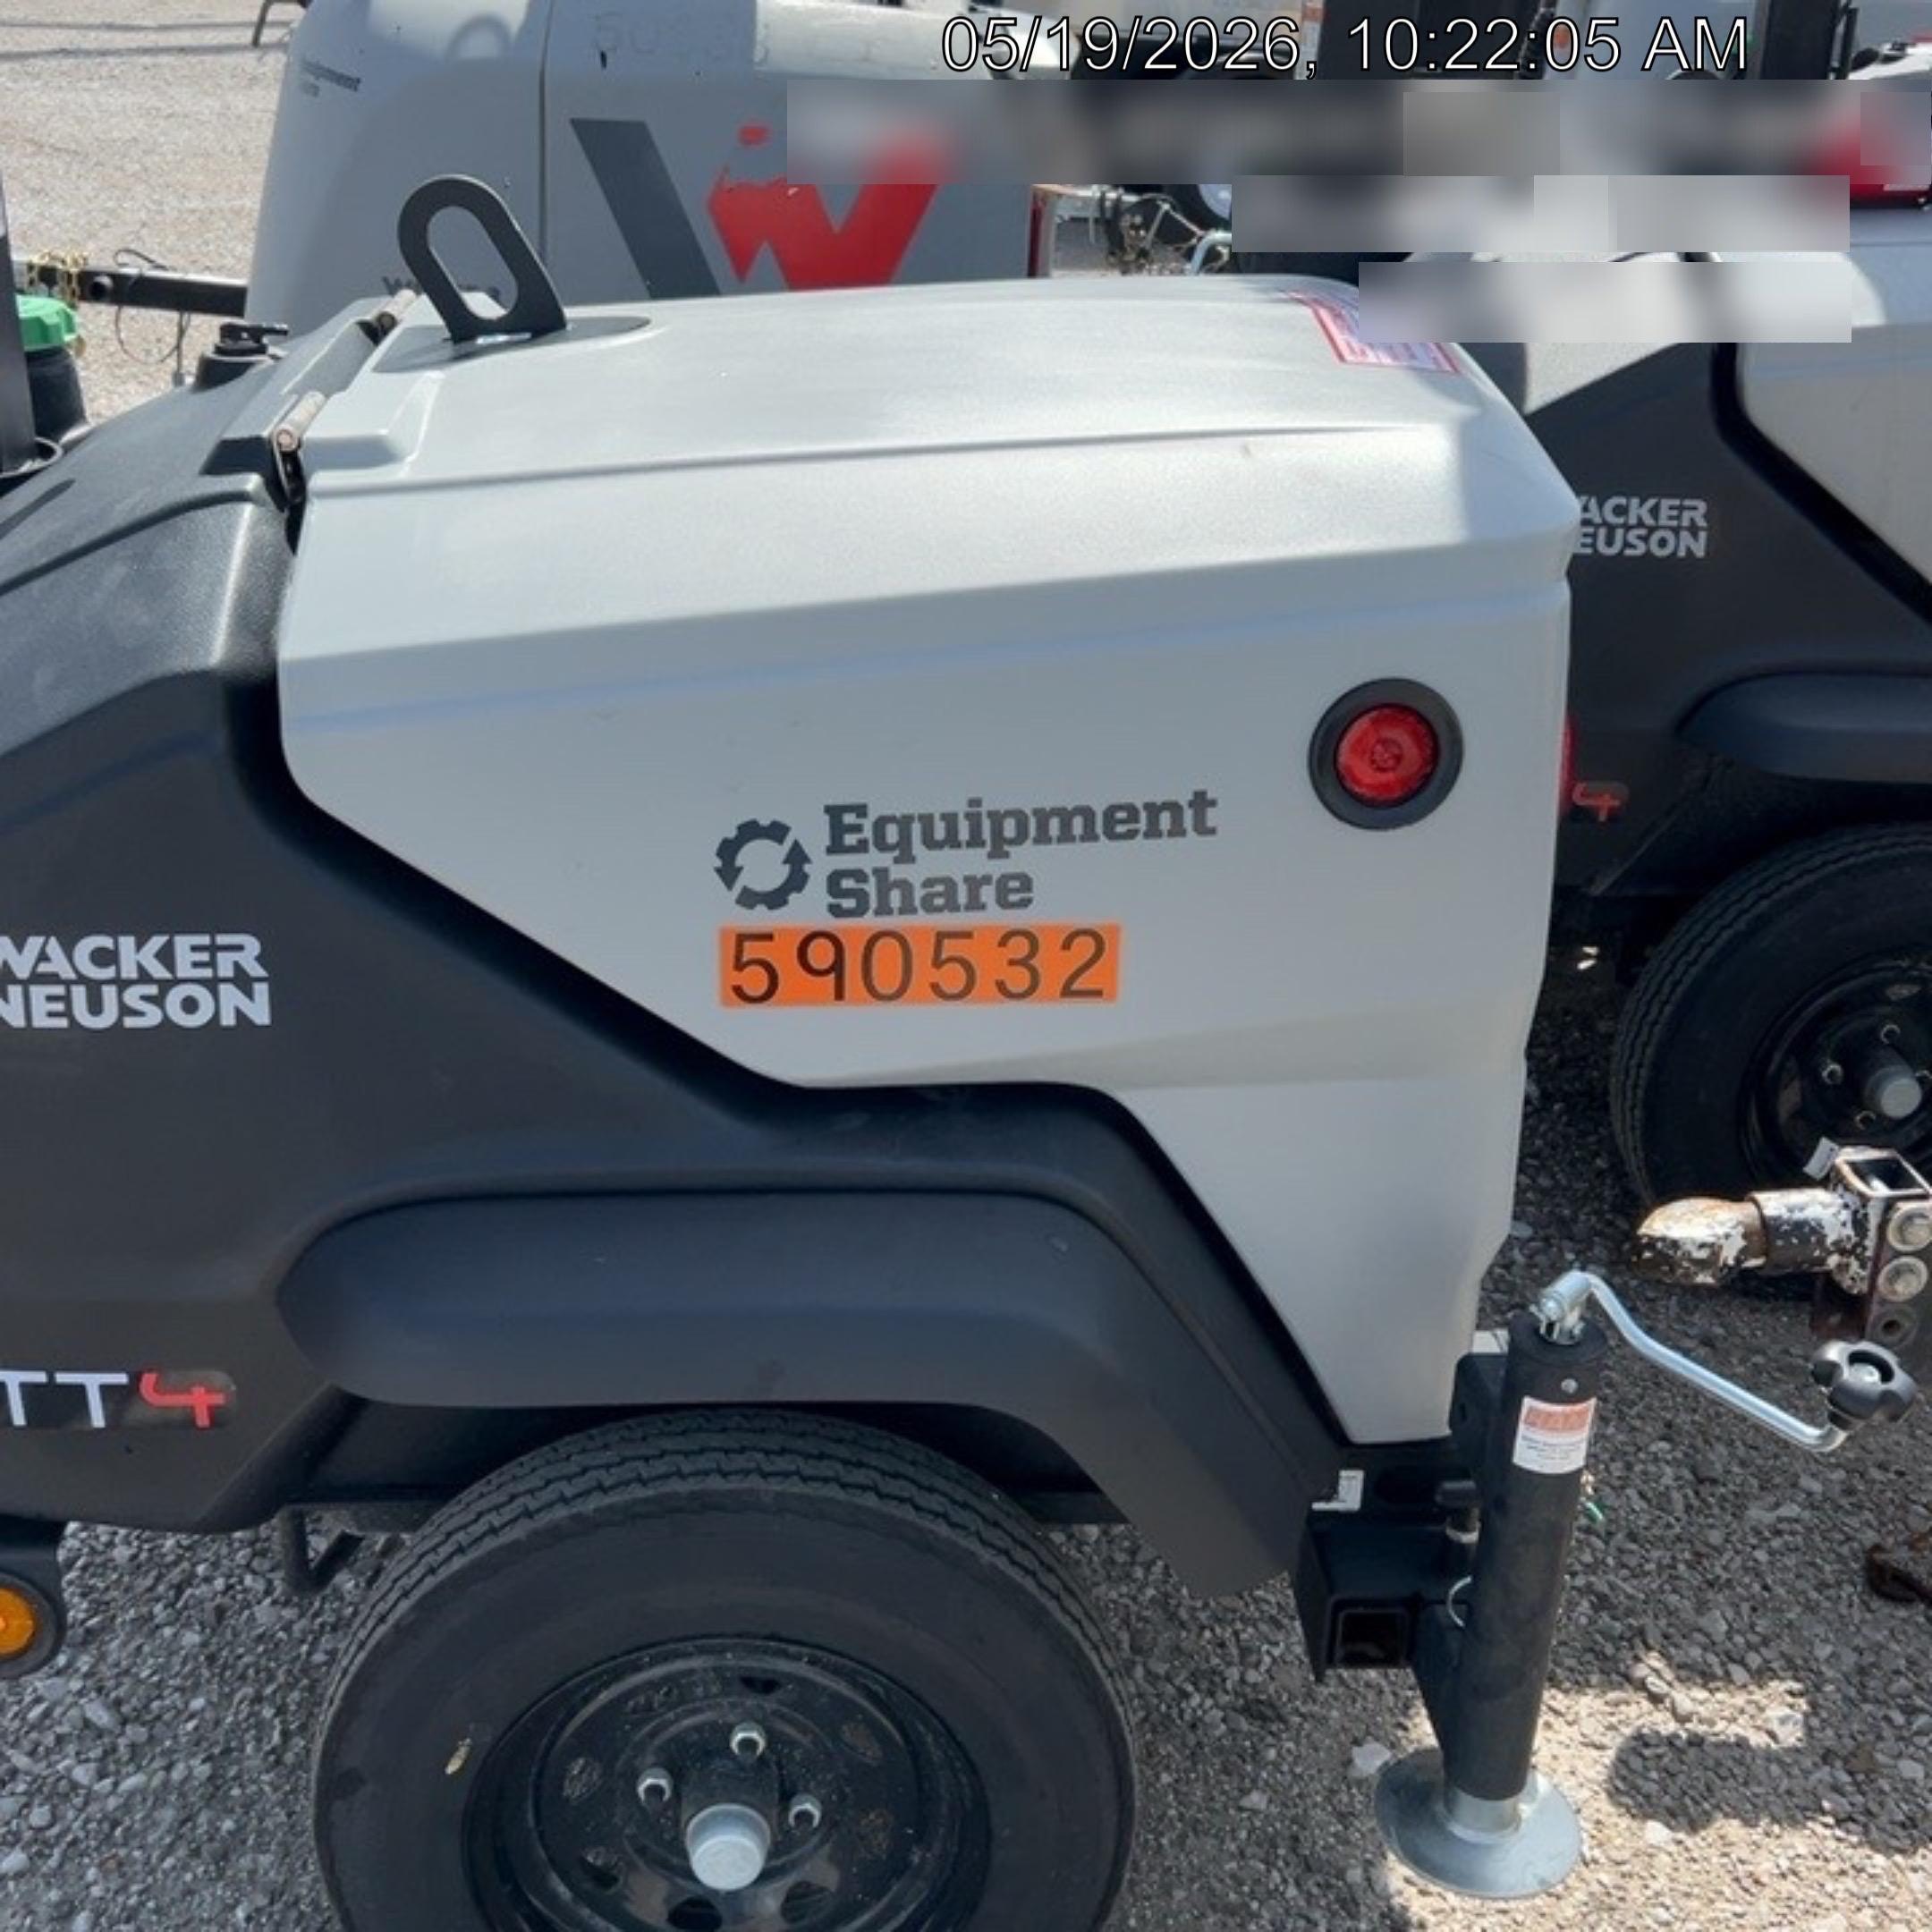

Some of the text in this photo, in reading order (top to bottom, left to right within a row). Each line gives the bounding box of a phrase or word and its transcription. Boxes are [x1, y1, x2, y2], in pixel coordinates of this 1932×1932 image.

[1580, 496, 1707, 527] ACKER
[1574, 526, 1707, 558] EUSON
[824, 790, 1218, 864] Equipment
[826, 869, 1035, 919] Share
[731, 928, 1107, 1004] 590532
